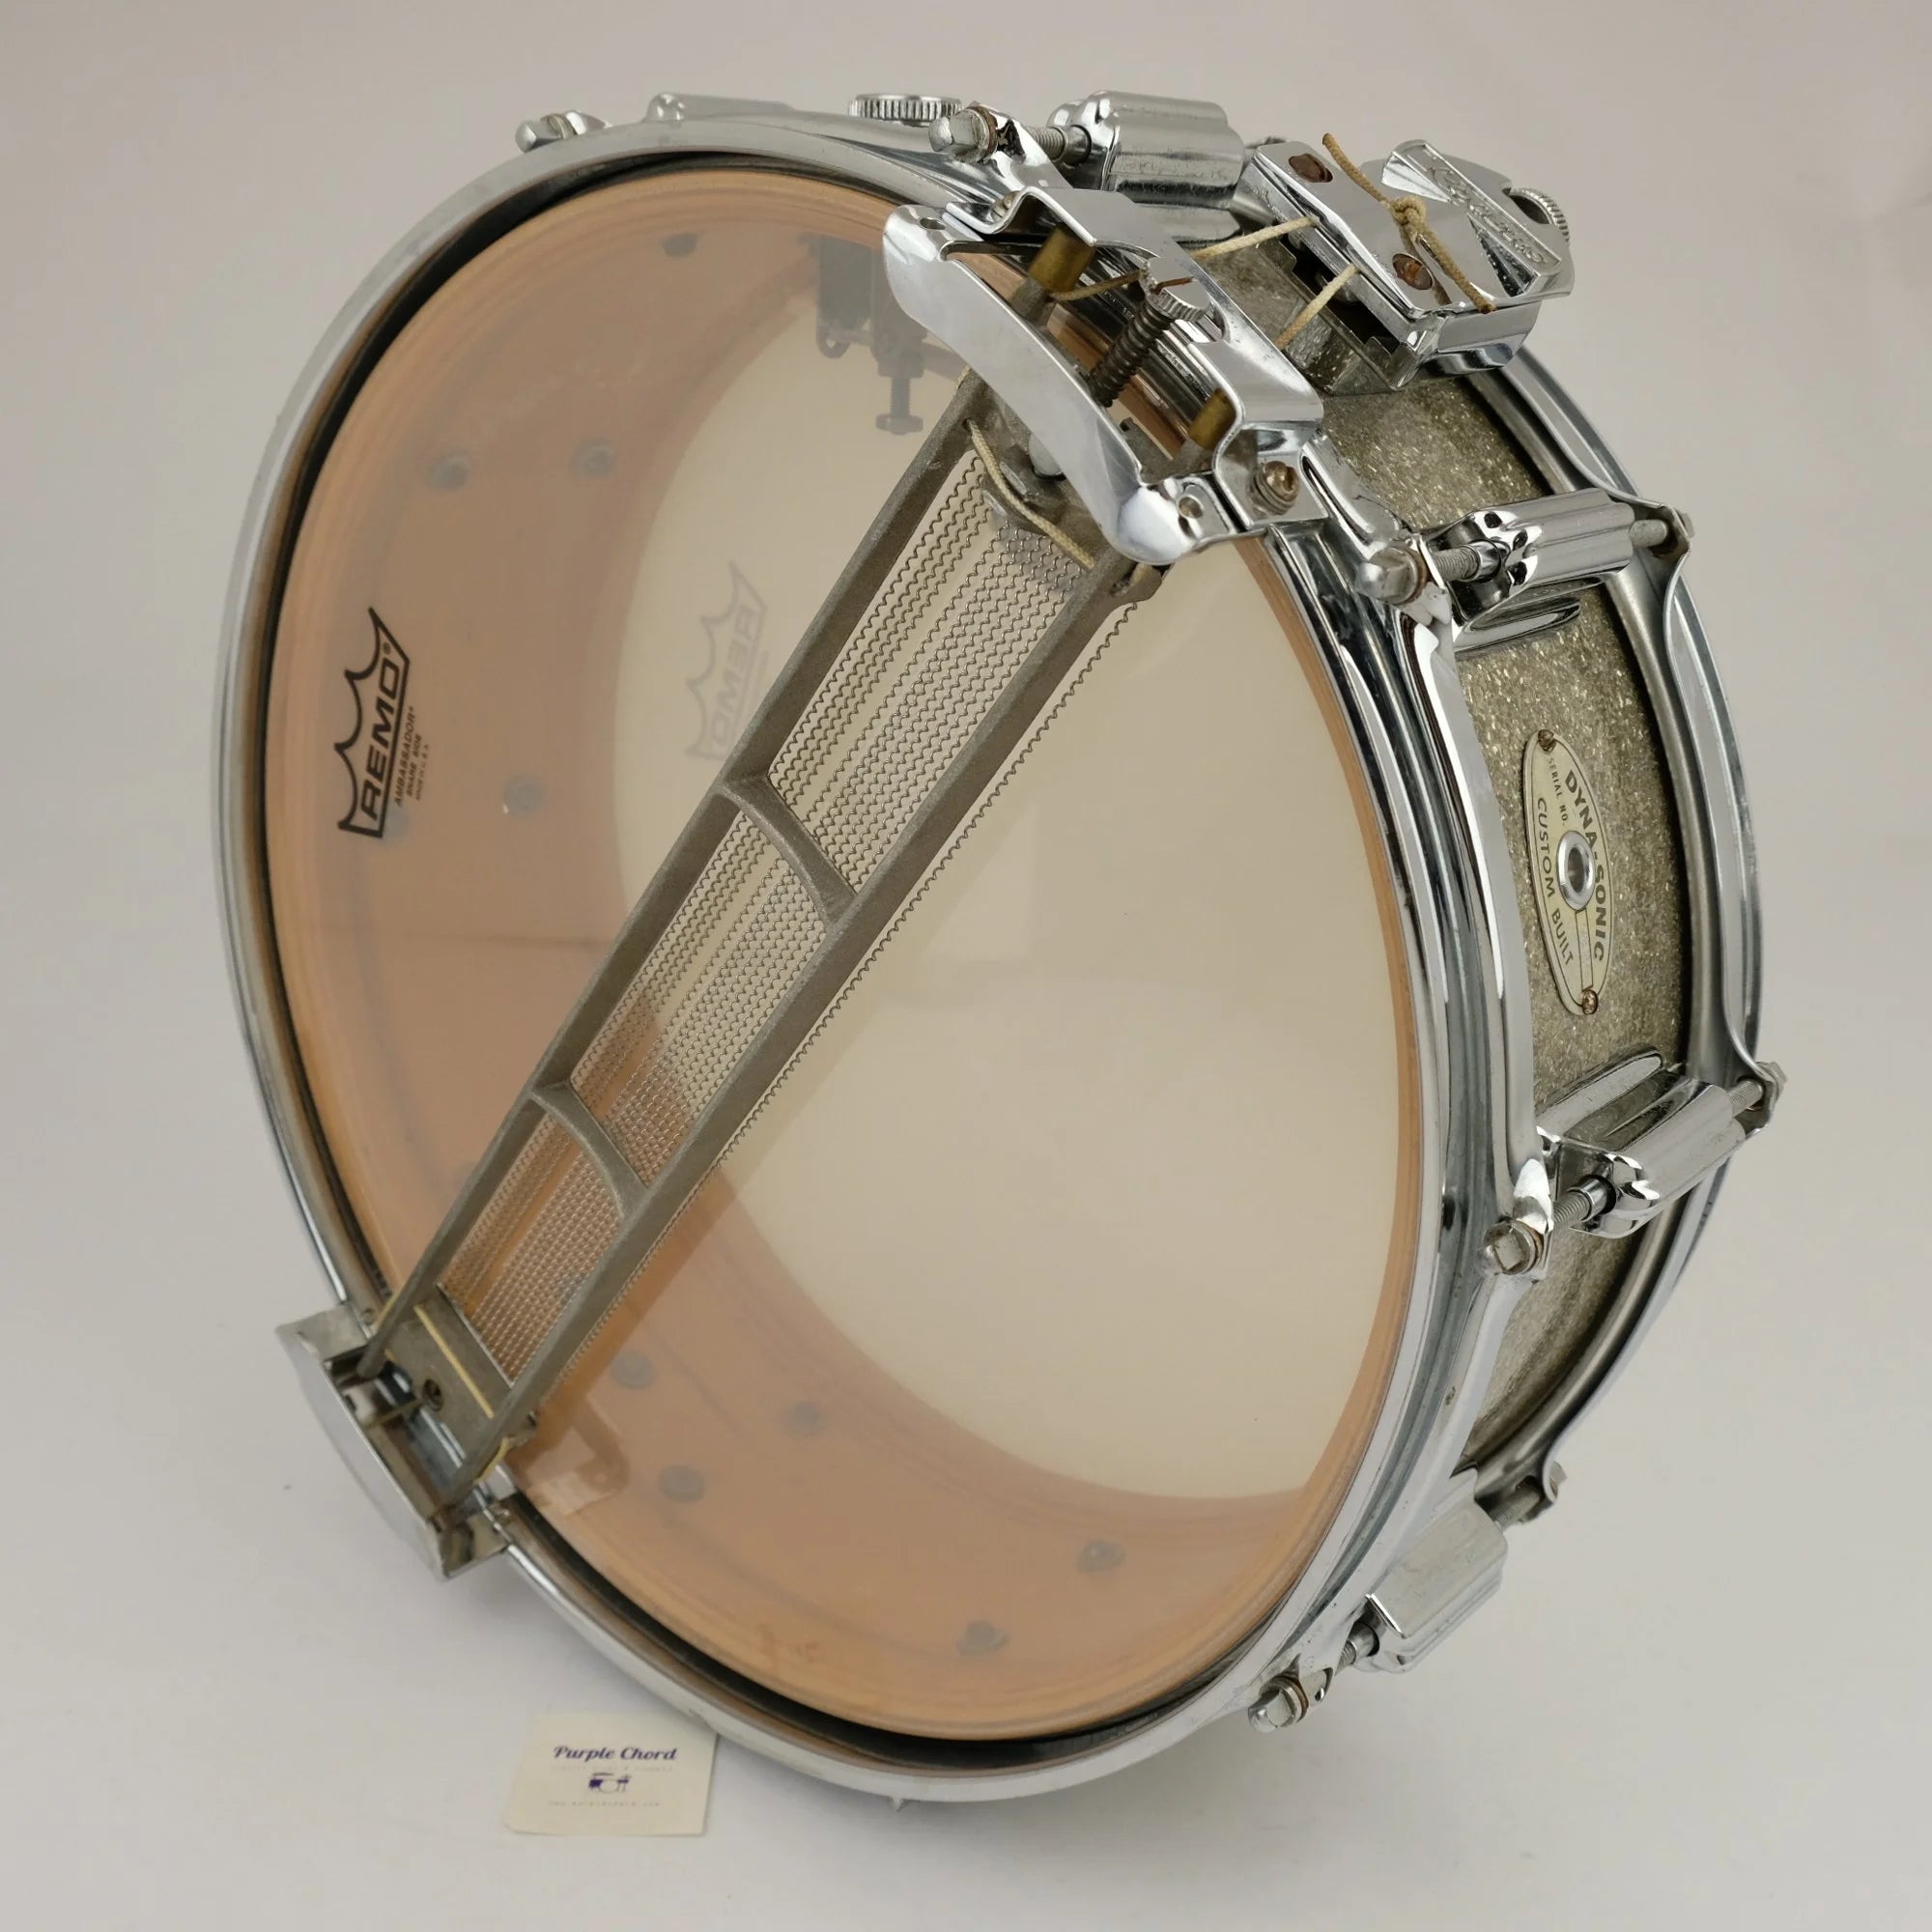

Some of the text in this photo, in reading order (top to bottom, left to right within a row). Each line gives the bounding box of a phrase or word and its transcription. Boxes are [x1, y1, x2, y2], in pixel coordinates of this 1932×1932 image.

[1548, 756, 1569, 826] SERIAL NO.
[1537, 797, 1574, 966] CUSTOM BUILT
[1565, 770, 1606, 962] DYNA-SONIC
[554, 1746, 677, 1762] Purple Chord
